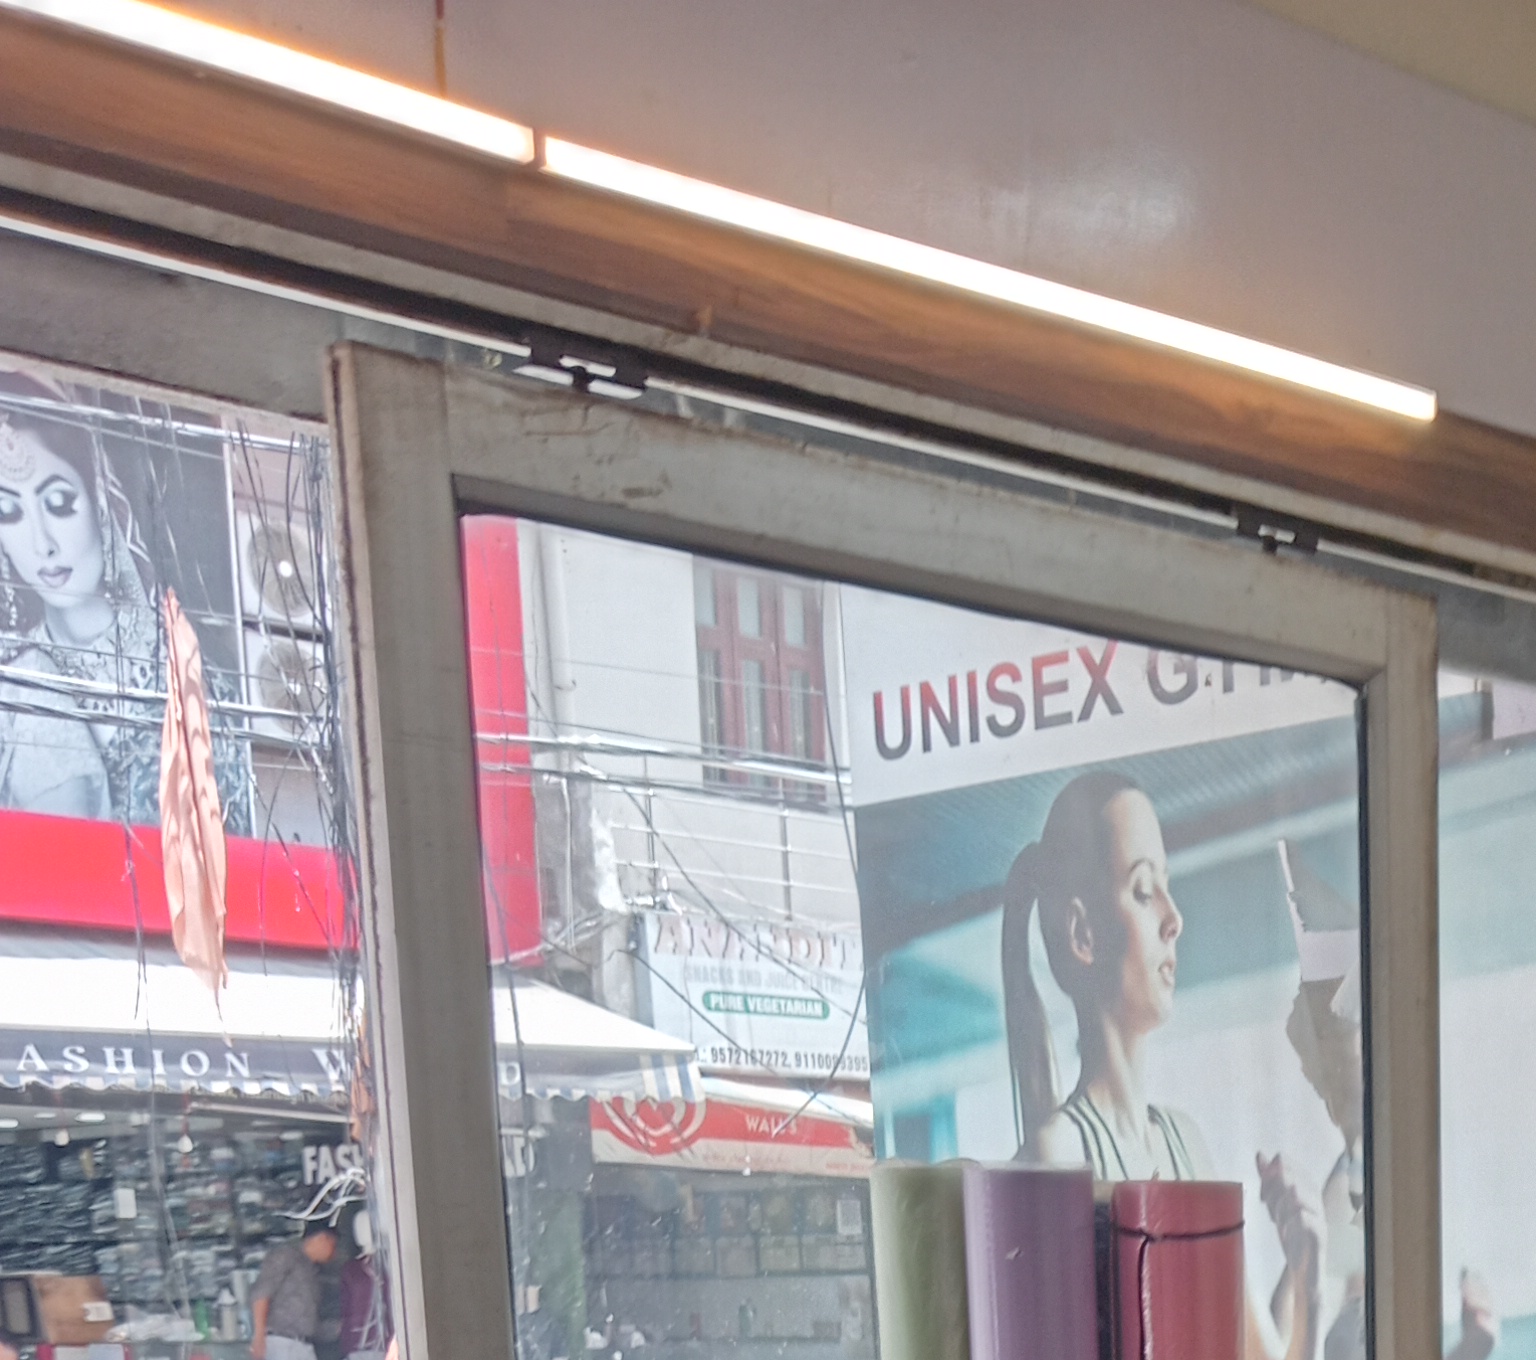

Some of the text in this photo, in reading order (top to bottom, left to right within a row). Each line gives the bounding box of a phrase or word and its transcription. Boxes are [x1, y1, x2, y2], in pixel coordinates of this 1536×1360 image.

[872, 638, 1125, 762] UNISEX
[709, 992, 824, 1017] PURE VEGETARIAN
